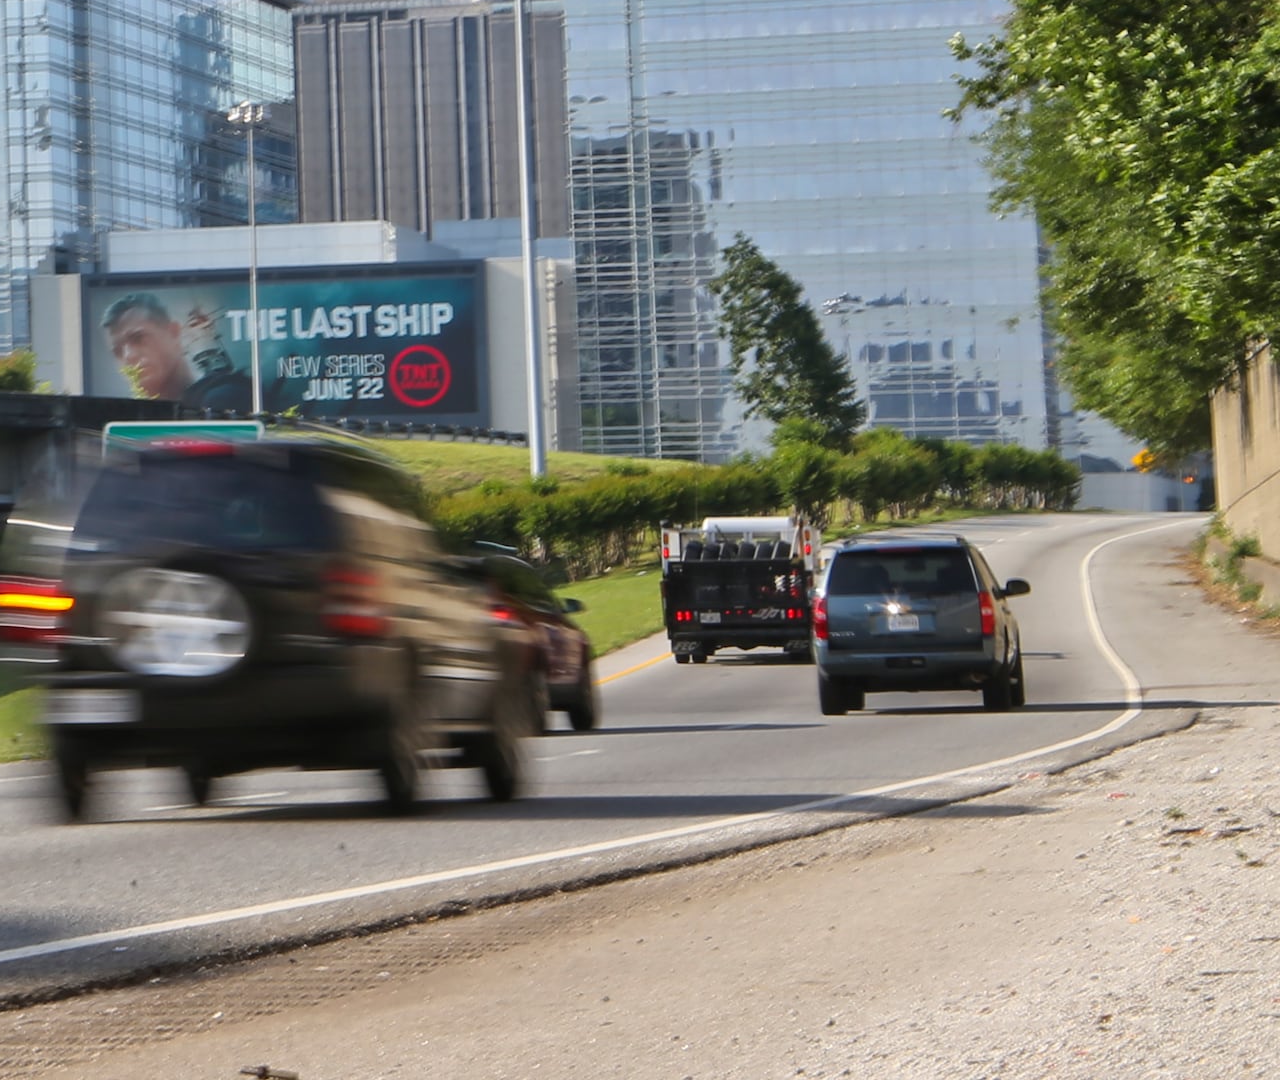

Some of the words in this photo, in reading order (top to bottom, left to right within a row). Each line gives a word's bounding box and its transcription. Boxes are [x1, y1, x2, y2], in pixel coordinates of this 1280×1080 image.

[227, 308, 287, 340] THE
[292, 306, 371, 338] LAST
[374, 303, 453, 337] SHIP
[279, 358, 321, 378] NEW
[326, 355, 385, 376] SERIES
[401, 364, 441, 380] TNT
[303, 379, 353, 400] JUNE
[358, 379, 384, 399] 22
